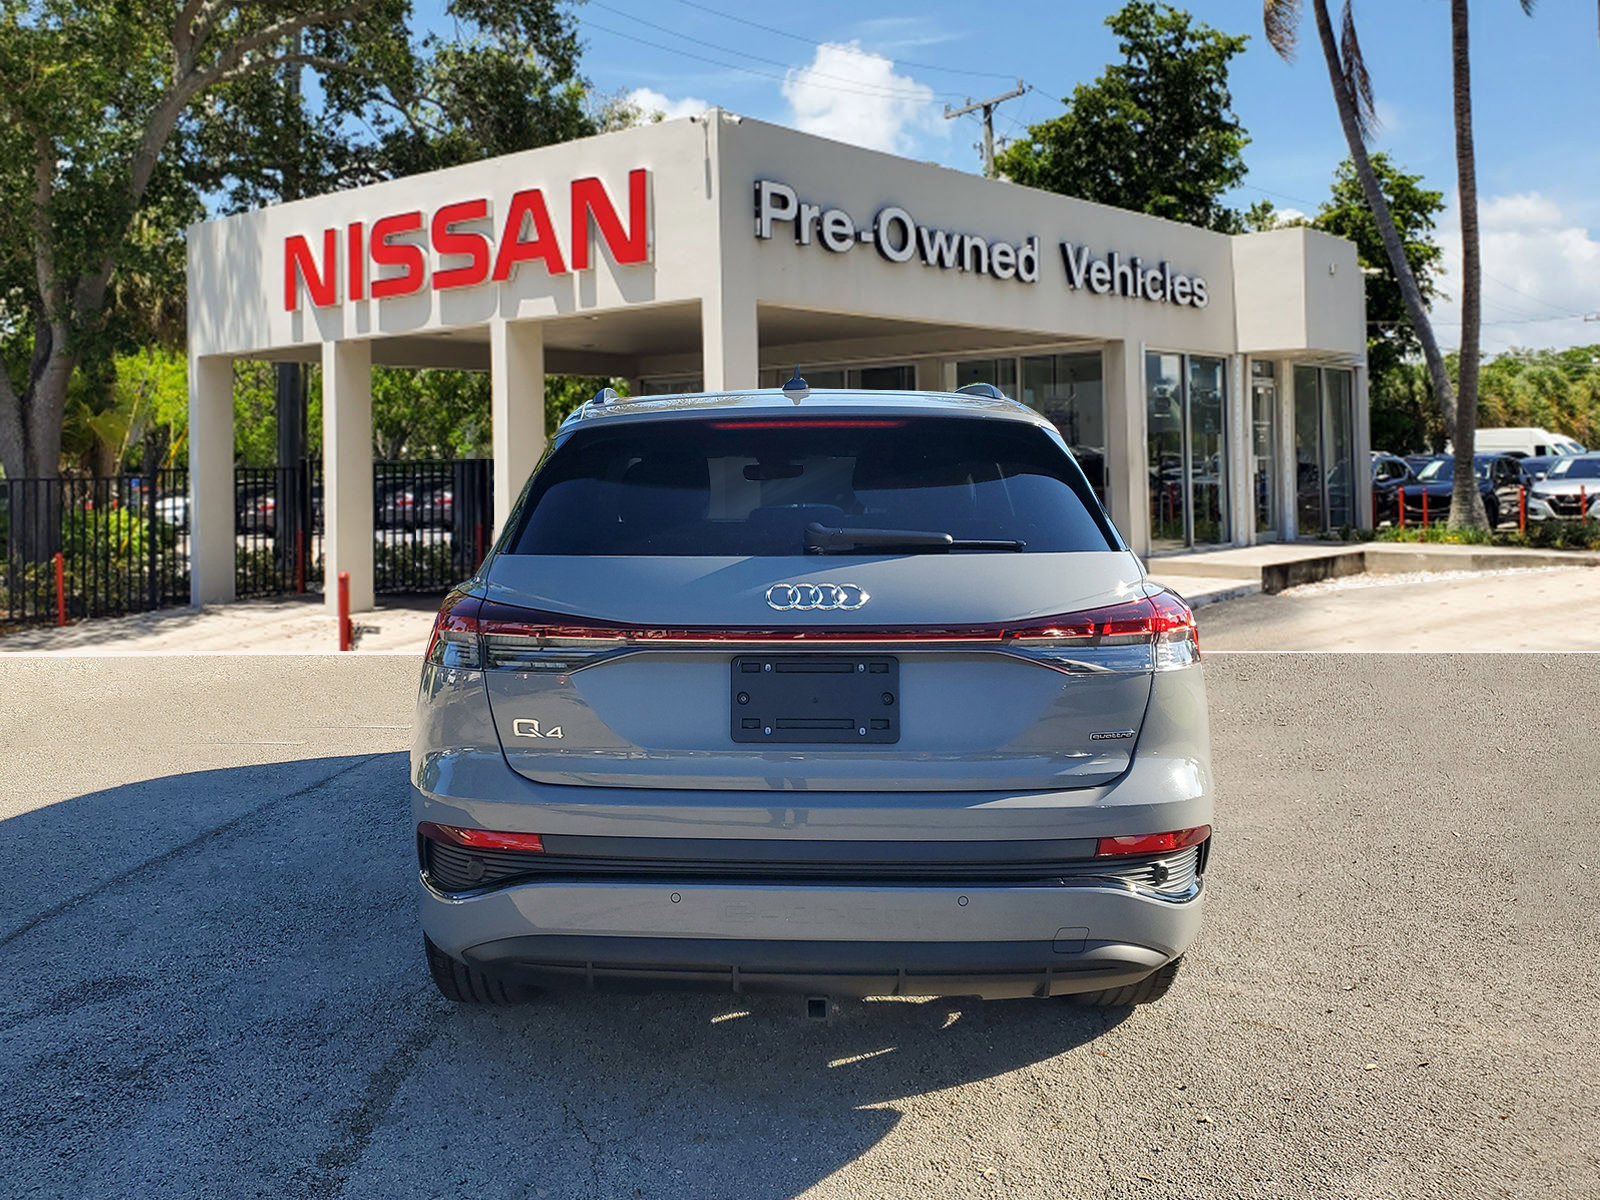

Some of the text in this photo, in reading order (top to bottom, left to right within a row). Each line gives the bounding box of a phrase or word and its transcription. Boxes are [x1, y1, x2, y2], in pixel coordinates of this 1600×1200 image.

[284, 168, 648, 312] NISSAN
[754, 179, 1209, 308] Pre-Owned Vehicles
